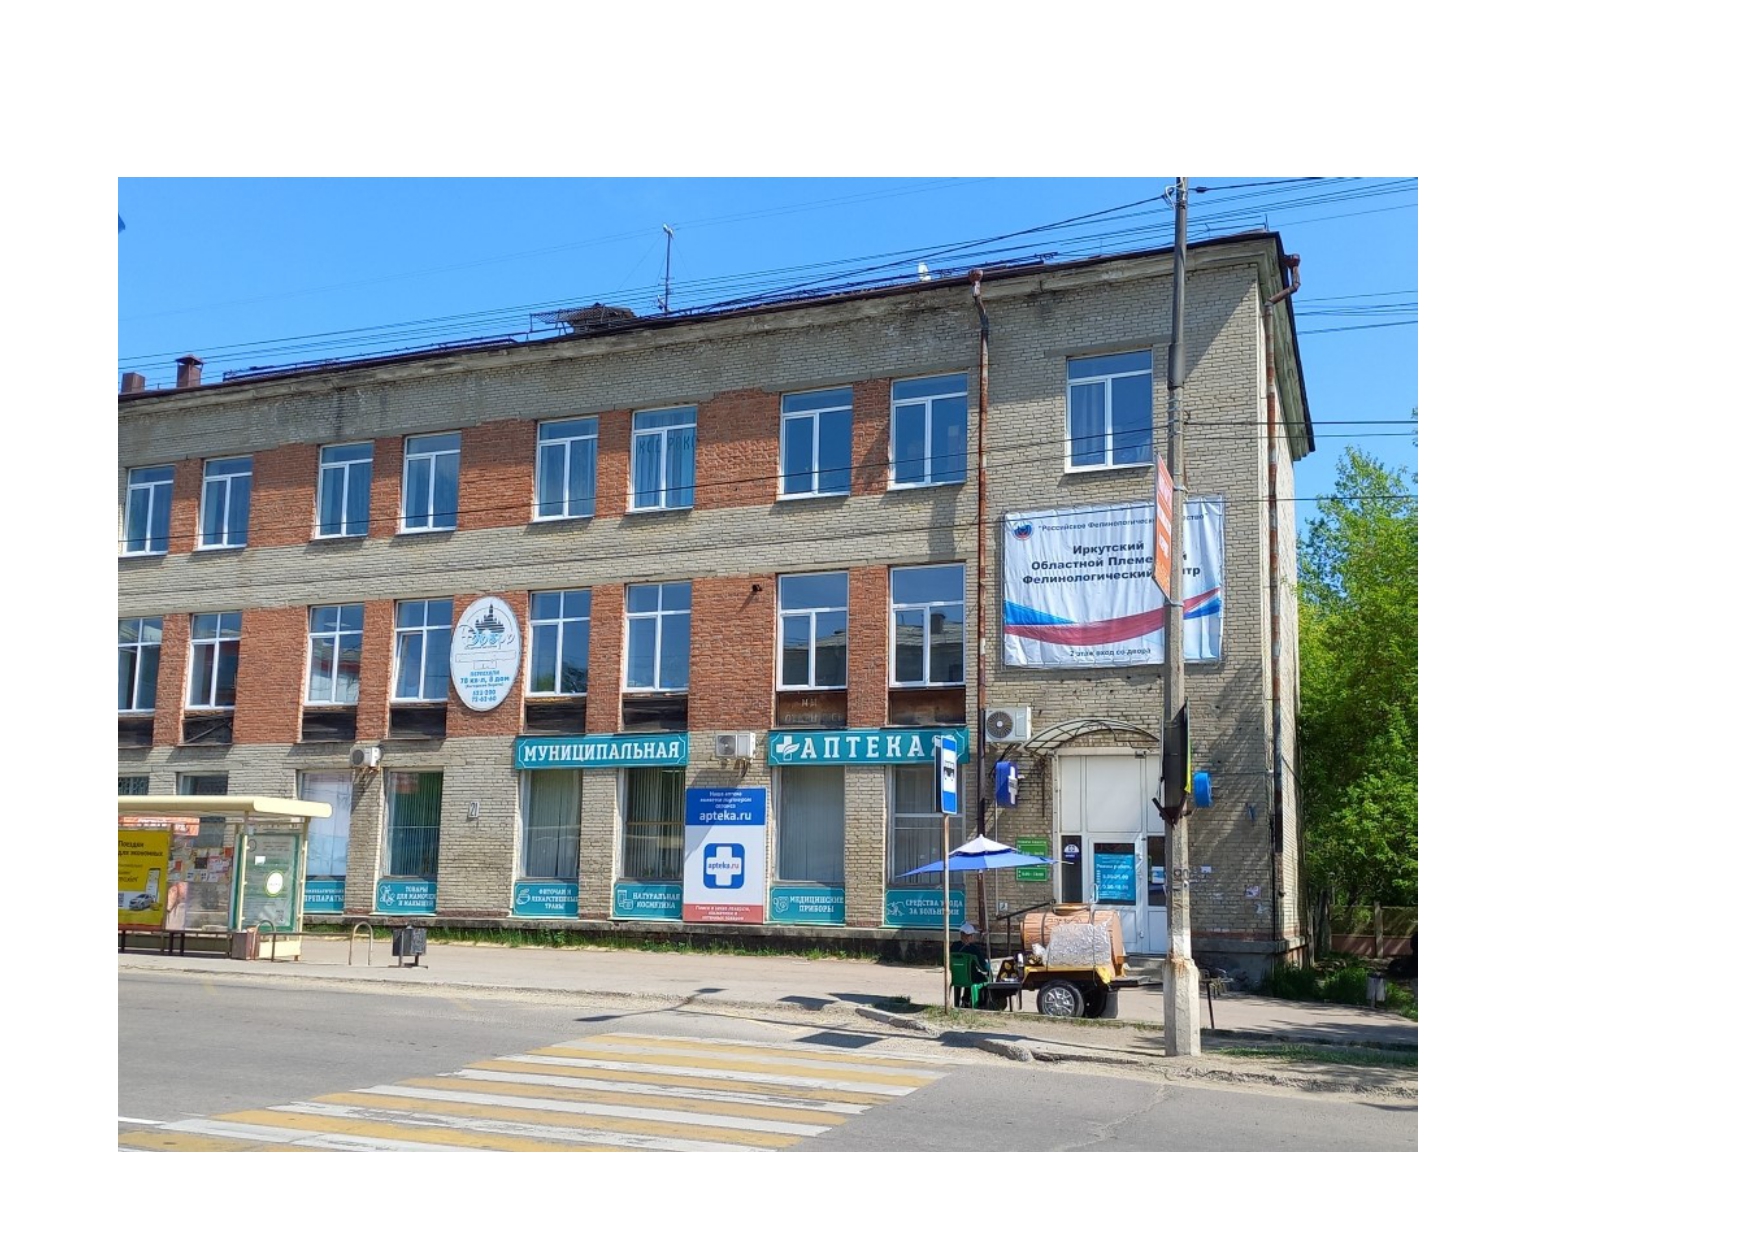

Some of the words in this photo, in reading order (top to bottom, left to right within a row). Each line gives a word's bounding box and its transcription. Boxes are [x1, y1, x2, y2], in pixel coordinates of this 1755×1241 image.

[1073, 540, 1144, 556] Иркутский
[1032, 557, 1104, 571] Областной
[1023, 569, 1154, 584] Фелинологический
[524, 741, 680, 762] МУНИЦИПАЛЬНАЯ
[800, 735, 925, 758] АПТЕКА
[699, 809, 752, 823] apteka.ru
[708, 861, 740, 870] apteka.ru
[789, 895, 844, 904] МЕДИЦИНСКИЕ
[905, 899, 939, 907] СРЕДСТВА
